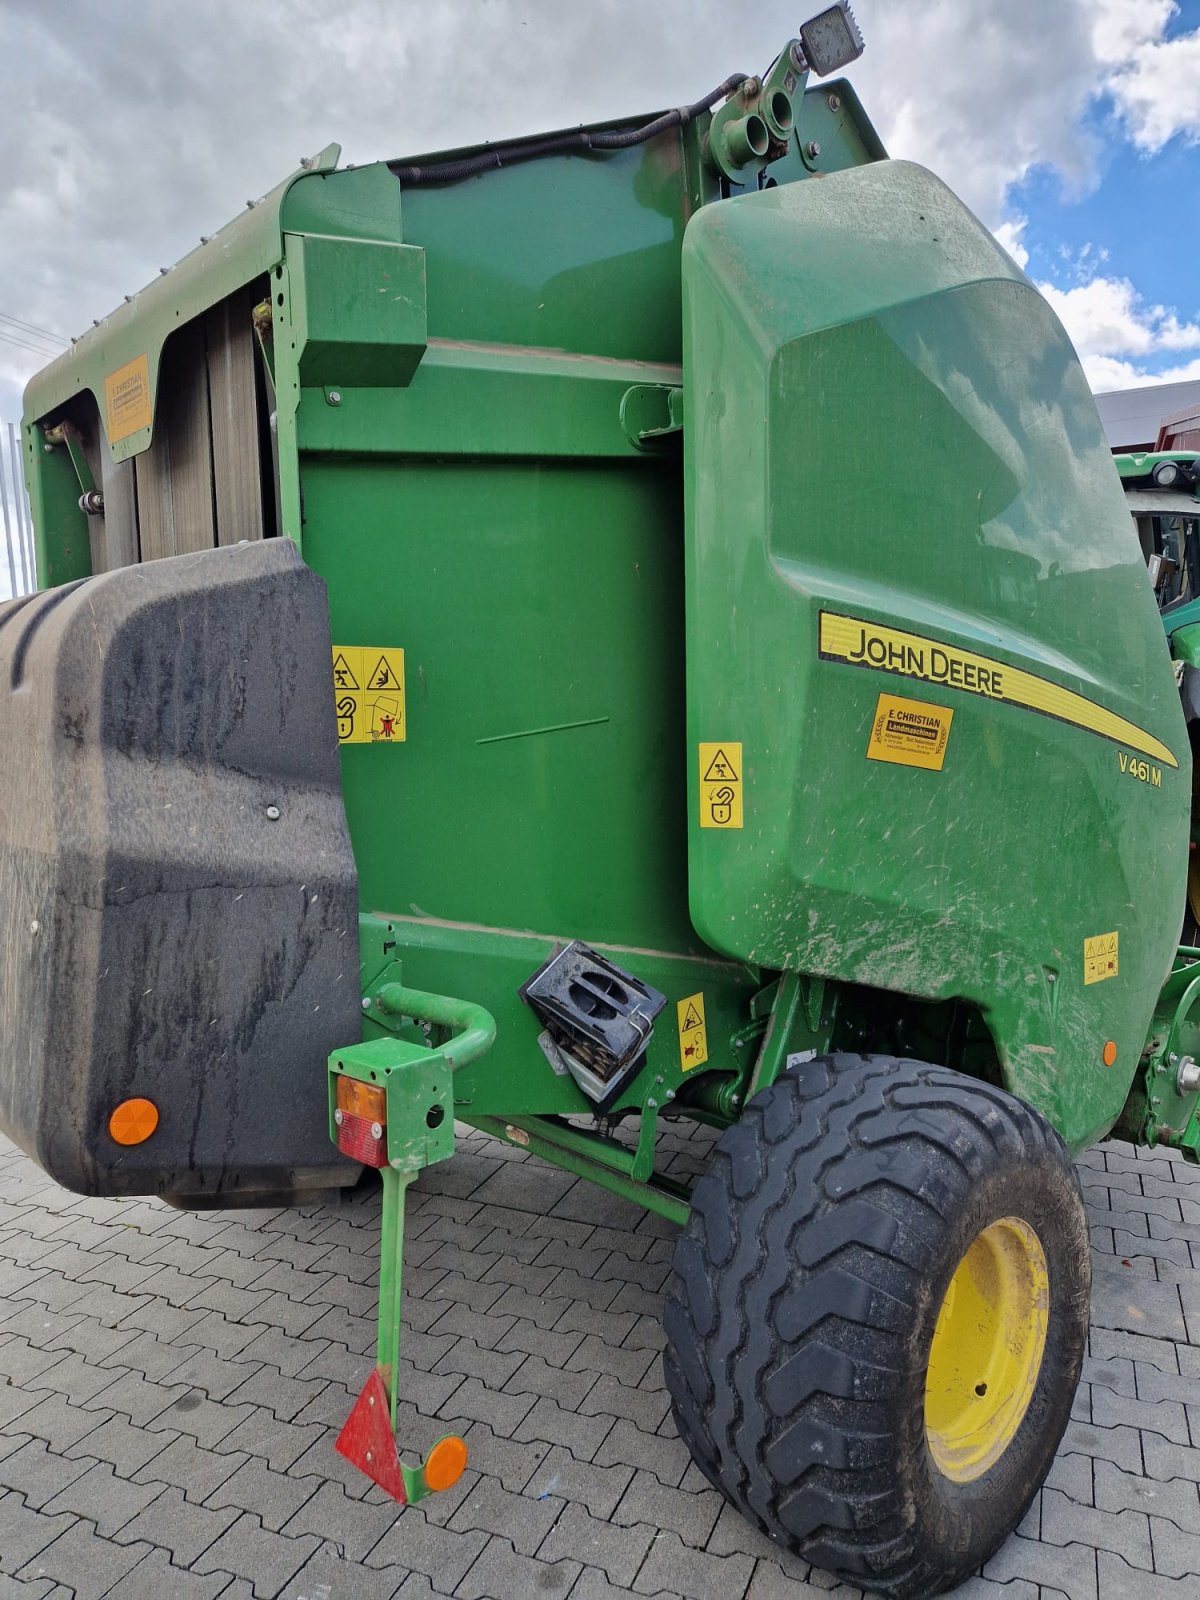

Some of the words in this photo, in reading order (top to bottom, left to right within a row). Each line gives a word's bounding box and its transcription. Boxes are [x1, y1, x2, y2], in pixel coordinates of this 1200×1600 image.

[850, 629, 924, 674] JOHN
[931, 648, 1003, 695] DEERE
[888, 709, 896, 719] E.
[896, 711, 940, 728] CHRISTIAN
[888, 722, 936, 738] Landmaschinen
[1118, 751, 1128, 774] V
[1129, 757, 1150, 784] 461
[1152, 765, 1162, 789] M
